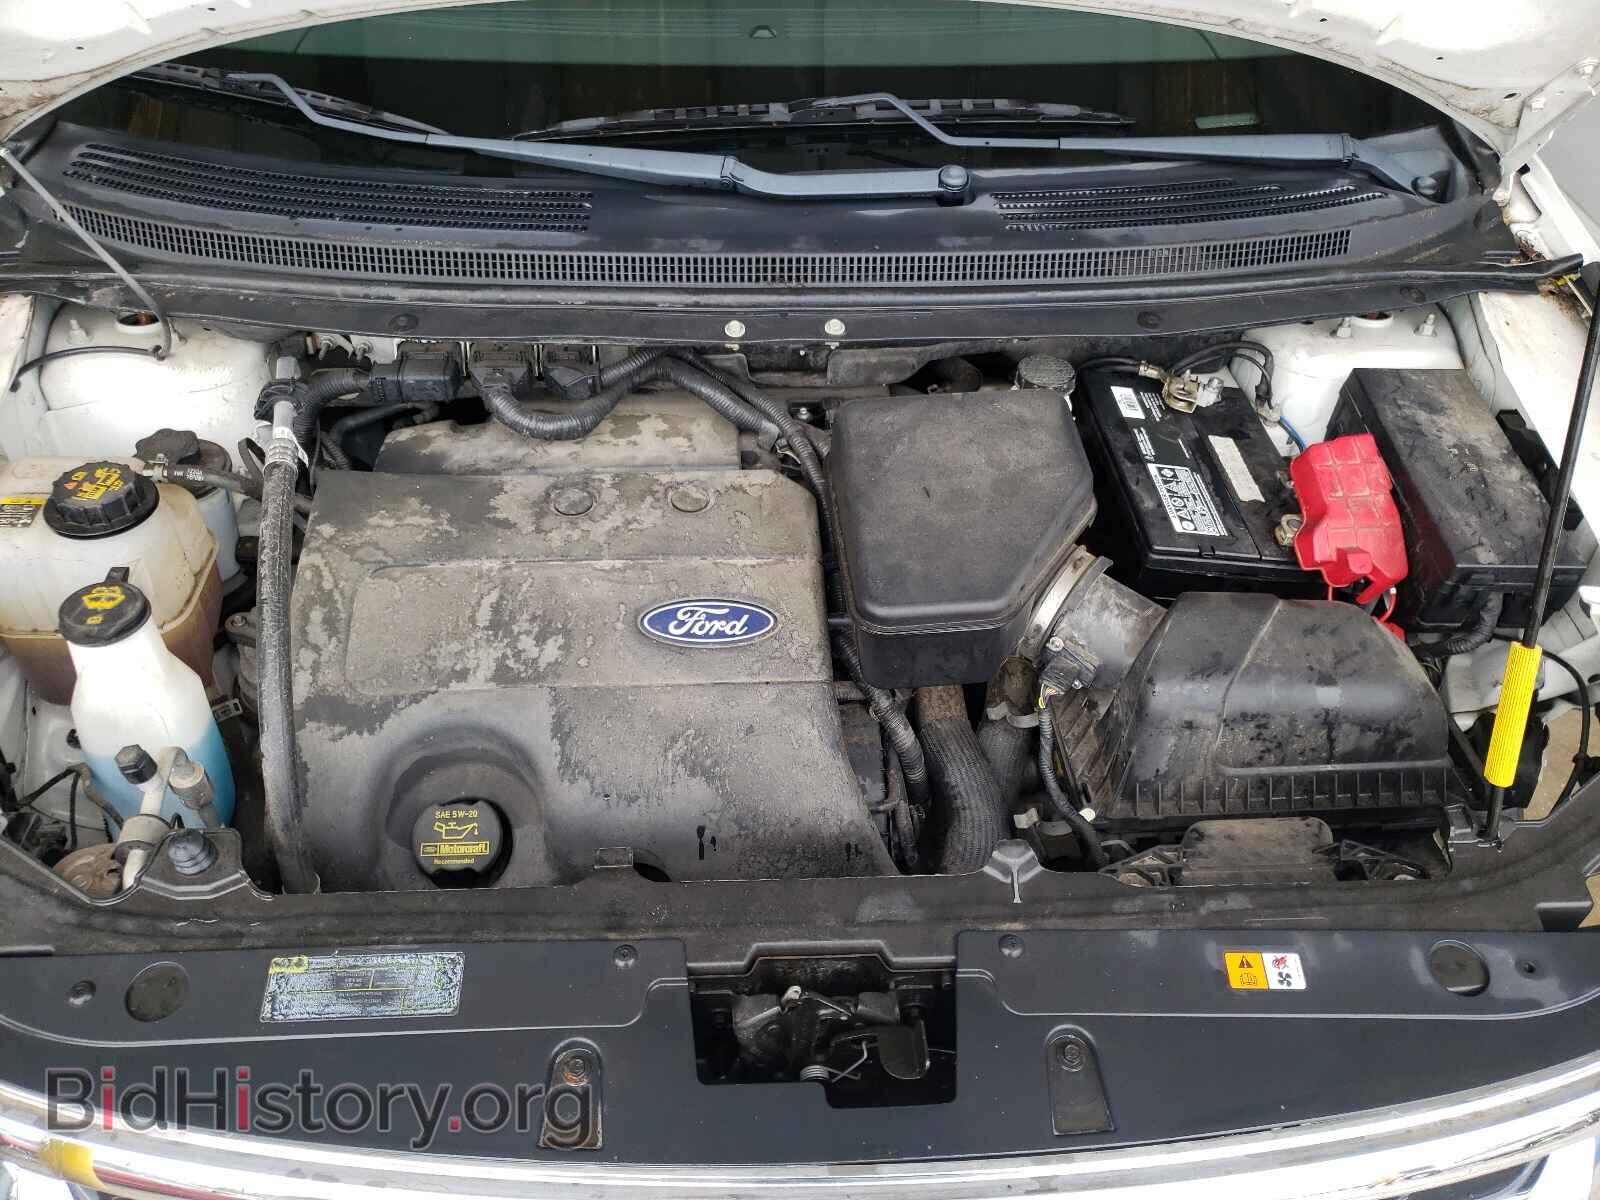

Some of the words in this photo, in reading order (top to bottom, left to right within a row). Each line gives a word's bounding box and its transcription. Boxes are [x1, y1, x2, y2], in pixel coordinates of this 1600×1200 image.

[668, 606, 749, 636] Ford
[435, 810, 451, 819] SAE
[452, 809, 478, 818] 5W-20
[440, 844, 486, 854] Motorcraft
